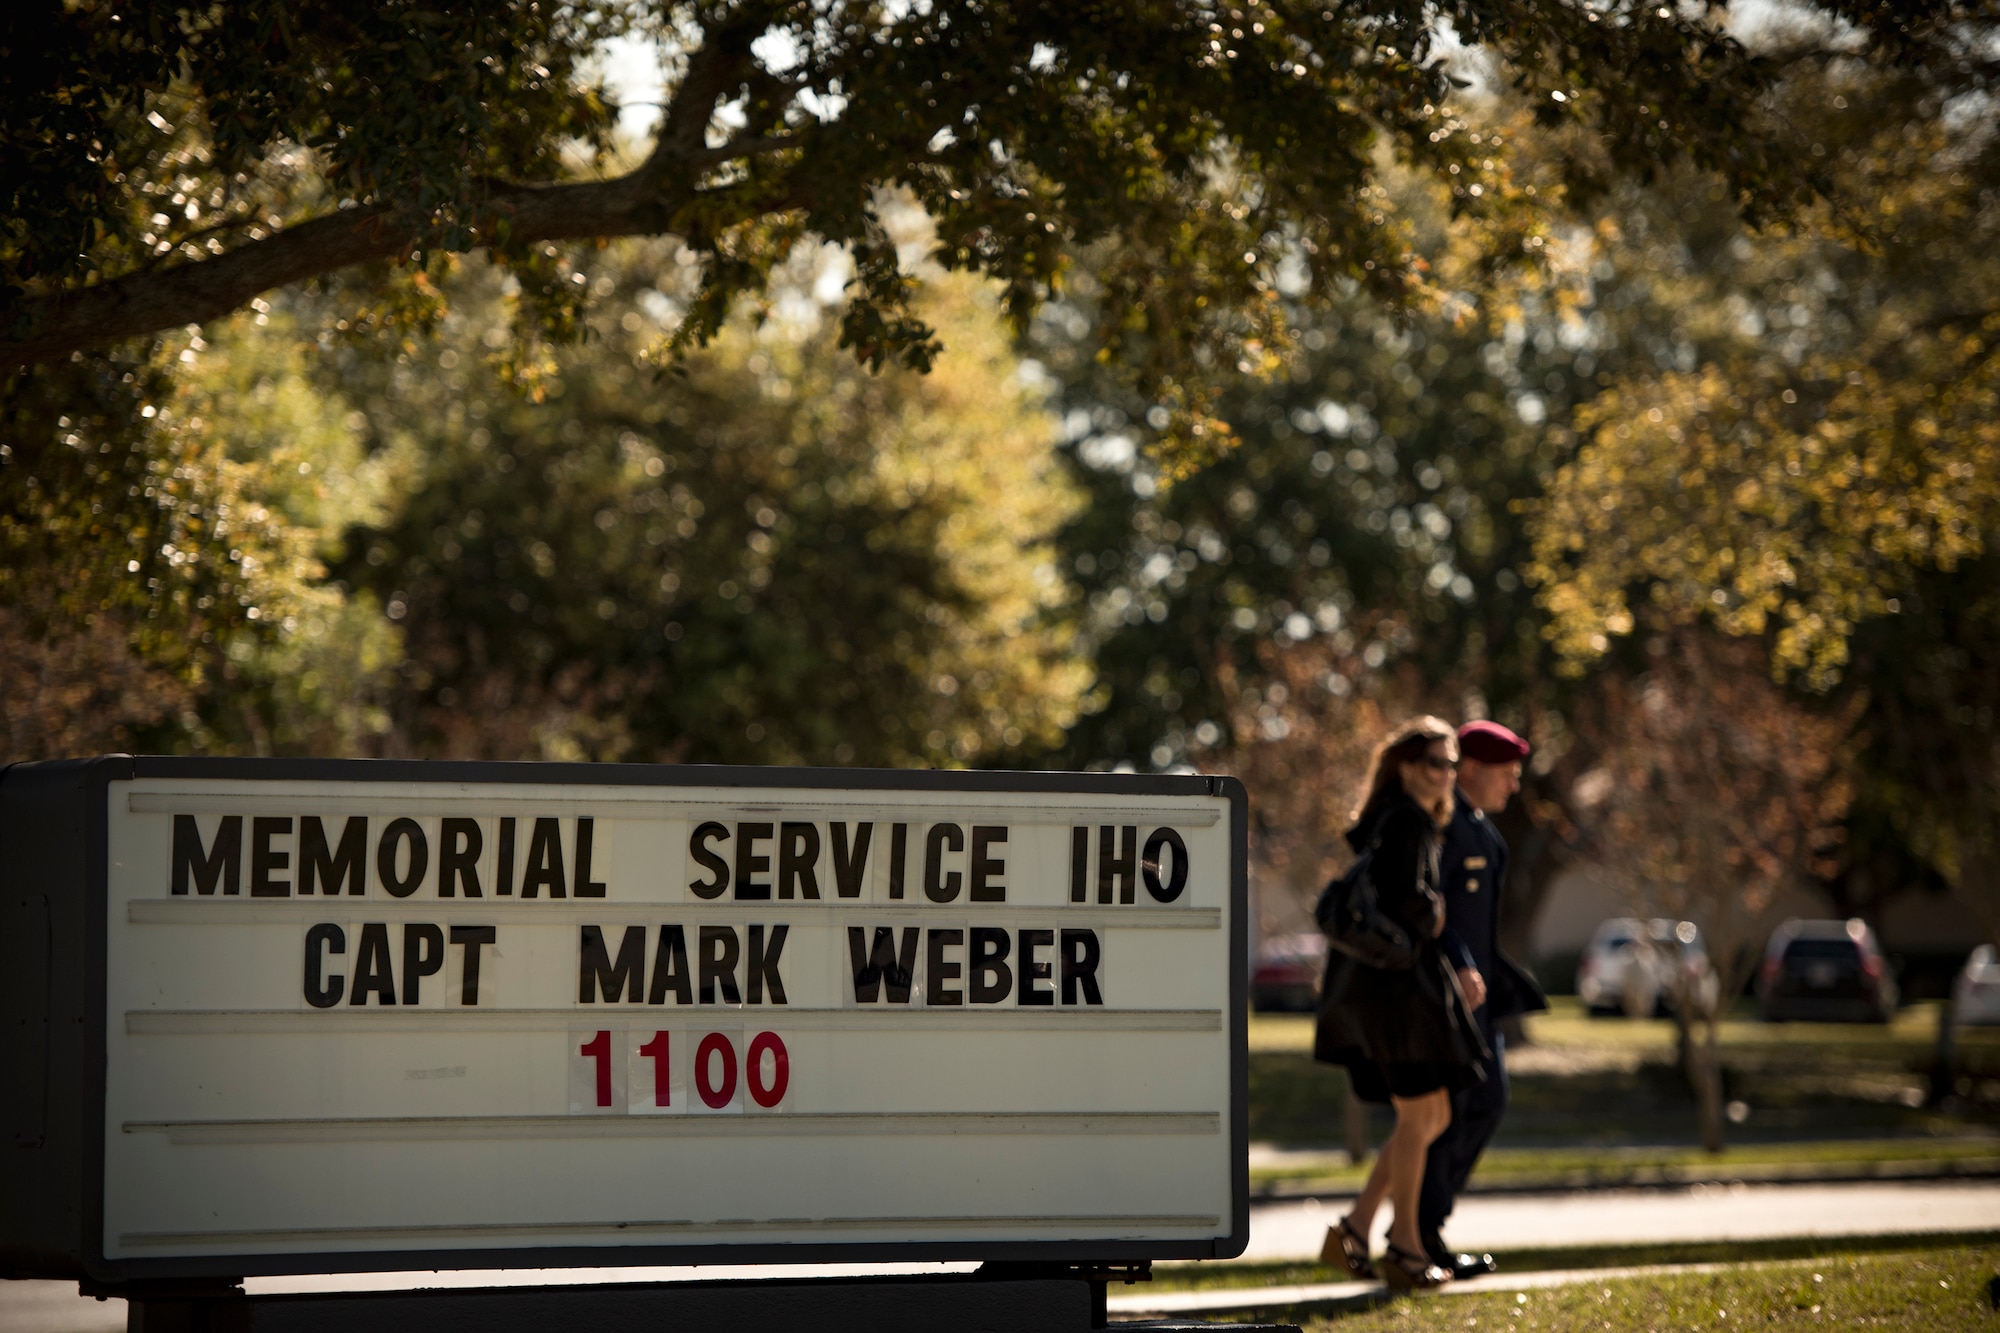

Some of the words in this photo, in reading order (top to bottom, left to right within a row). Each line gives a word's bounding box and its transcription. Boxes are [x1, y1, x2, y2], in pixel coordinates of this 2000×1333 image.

[171, 814, 606, 898] MEMORIAL
[689, 821, 1008, 903] SERVICE
[1070, 825, 1188, 904] IHO
[304, 923, 496, 1008] CAPT
[579, 924, 790, 1005] MARK
[847, 926, 1104, 1005] WEBER
[581, 1030, 789, 1109] 1100
